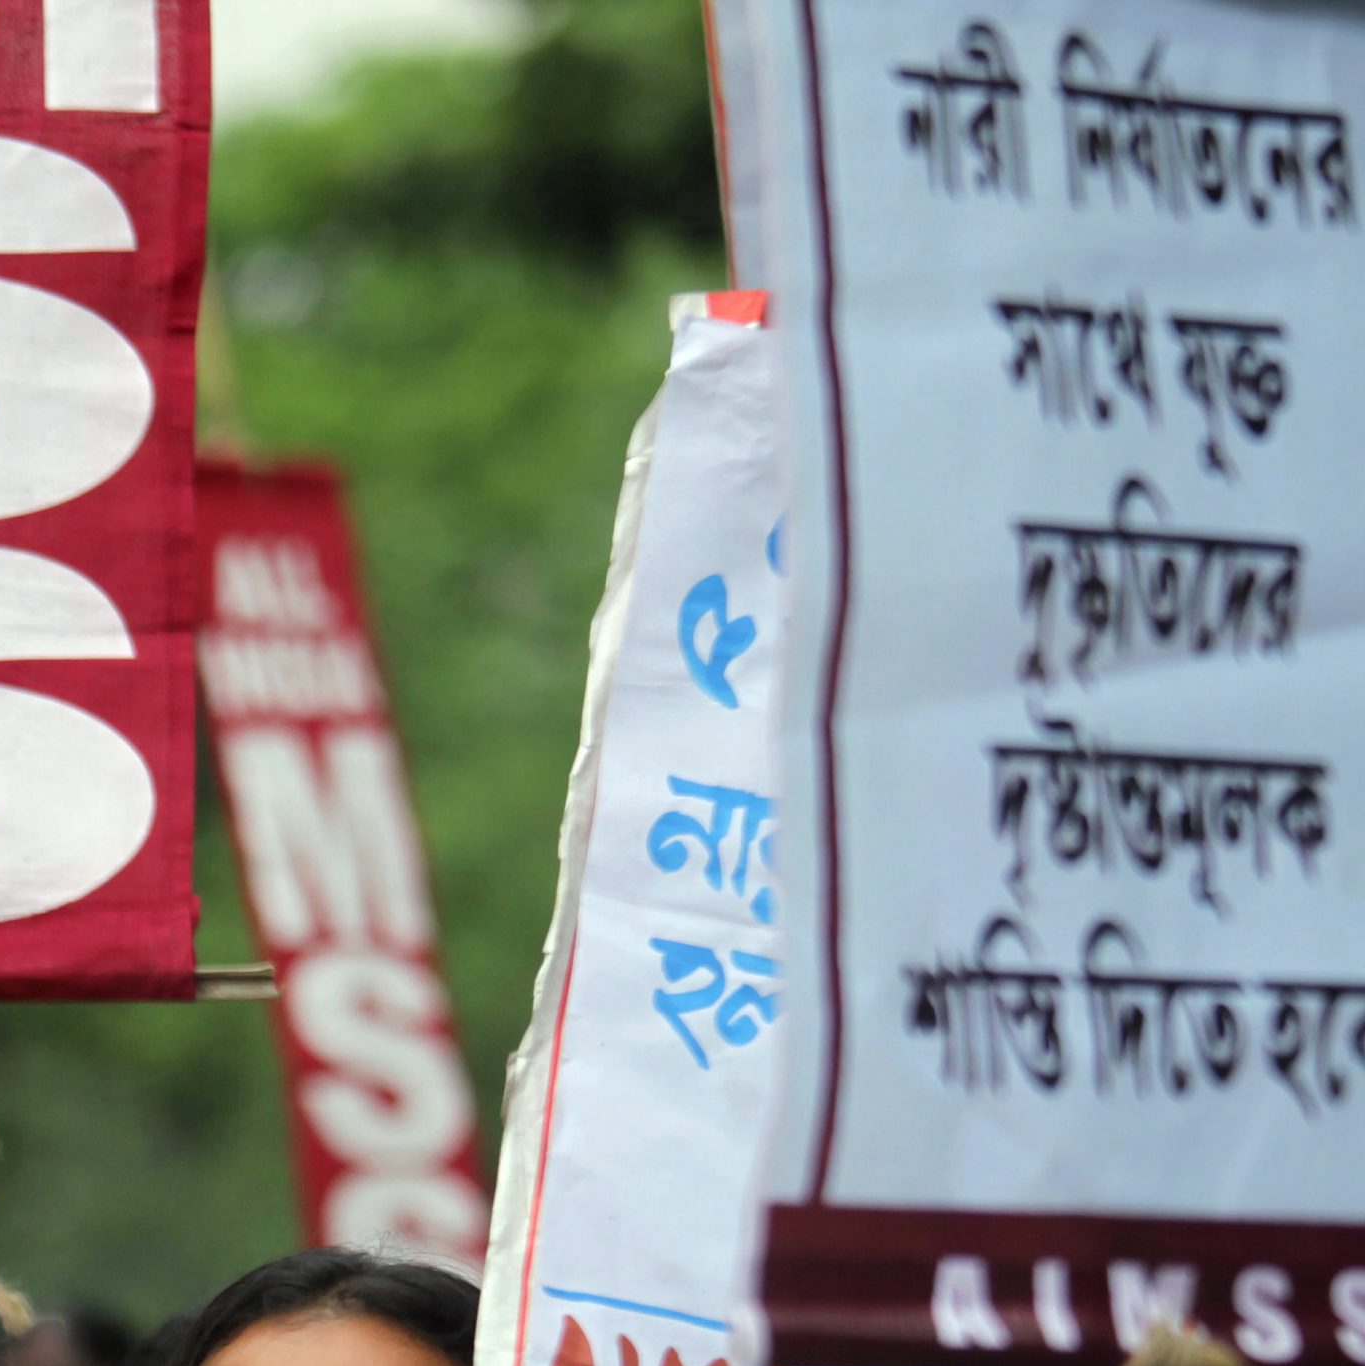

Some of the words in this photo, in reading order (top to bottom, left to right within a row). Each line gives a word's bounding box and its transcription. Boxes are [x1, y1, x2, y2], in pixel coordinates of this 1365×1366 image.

[892, 22, 1031, 202] নারী
[991, 285, 1161, 425] সাথে
[1077, 917, 1243, 1099] দিতে
